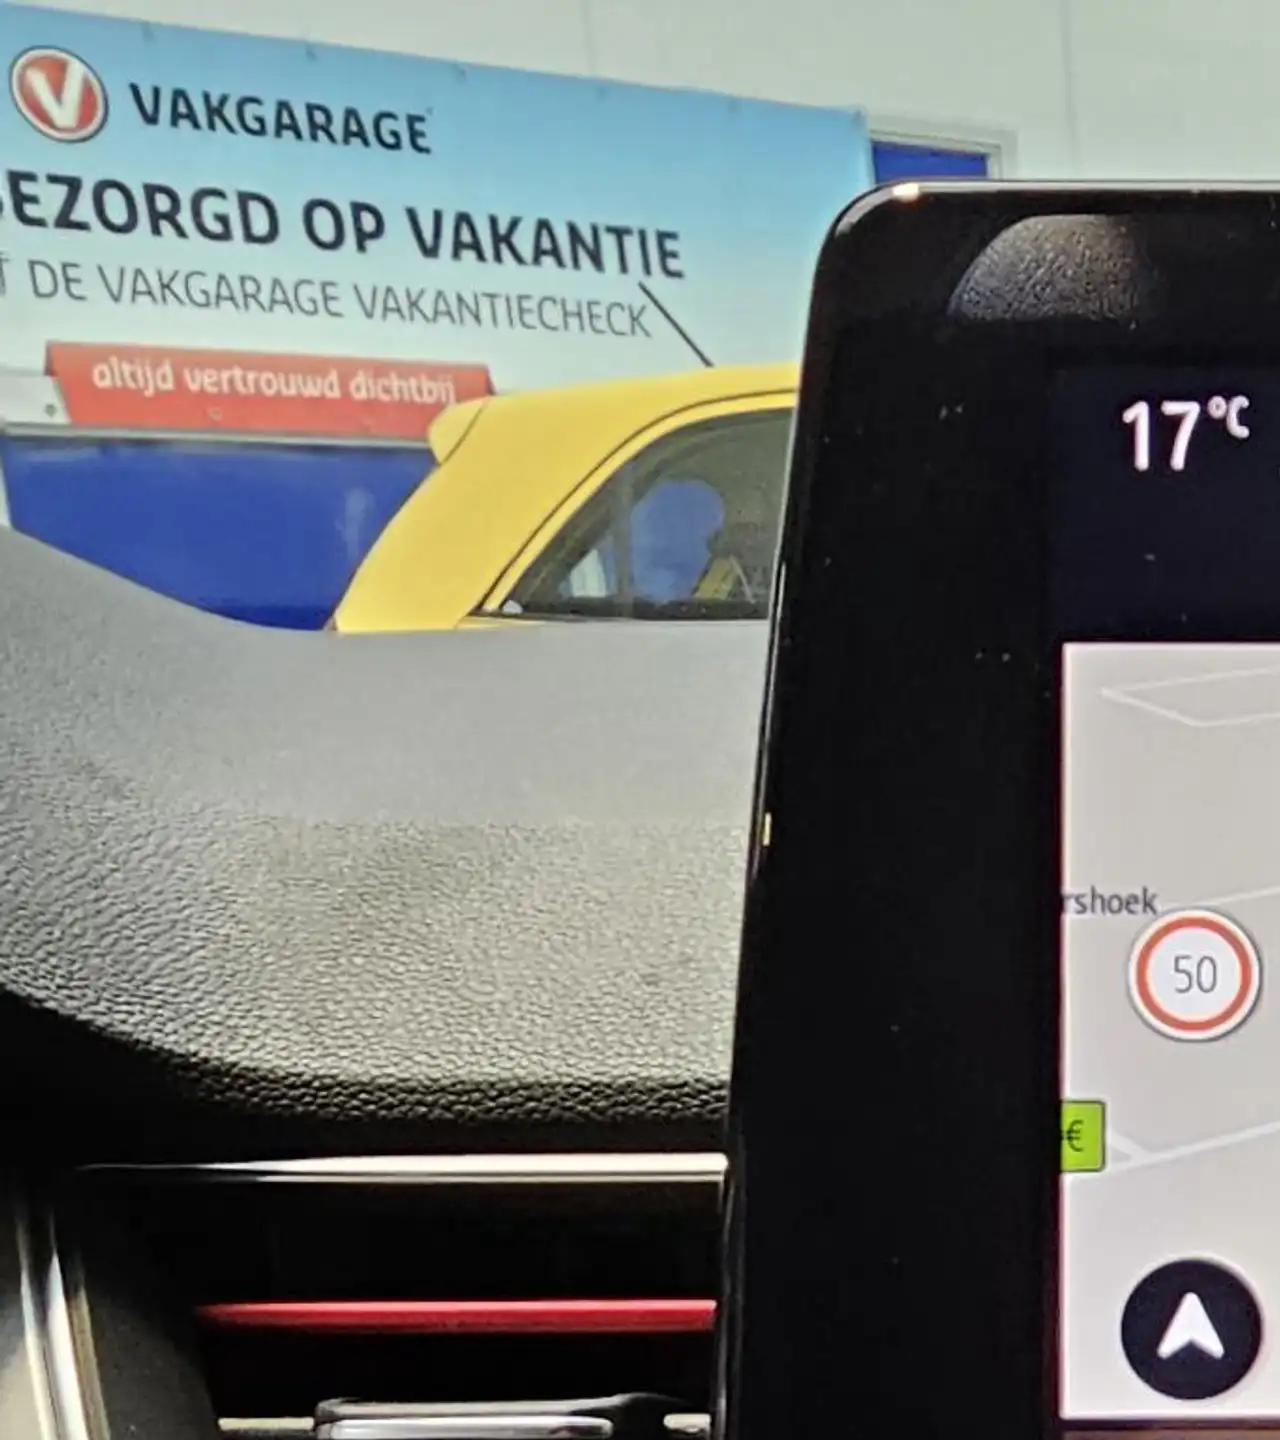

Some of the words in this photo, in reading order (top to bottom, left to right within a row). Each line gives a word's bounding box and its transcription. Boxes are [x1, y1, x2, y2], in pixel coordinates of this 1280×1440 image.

[129, 82, 432, 155] VAKGARAGE
[0, 169, 280, 244] EZORGD
[303, 198, 385, 253] OP
[405, 206, 686, 279] VAKANTIE
[29, 259, 87, 301] DE
[98, 264, 345, 318] VAKGARAGE
[353, 283, 653, 338] VAKANTIECHECK
[92, 355, 174, 398] altijd
[183, 364, 340, 399] vertrouwd
[349, 369, 456, 405] dichtbij
[1172, 954, 1218, 995] 50
